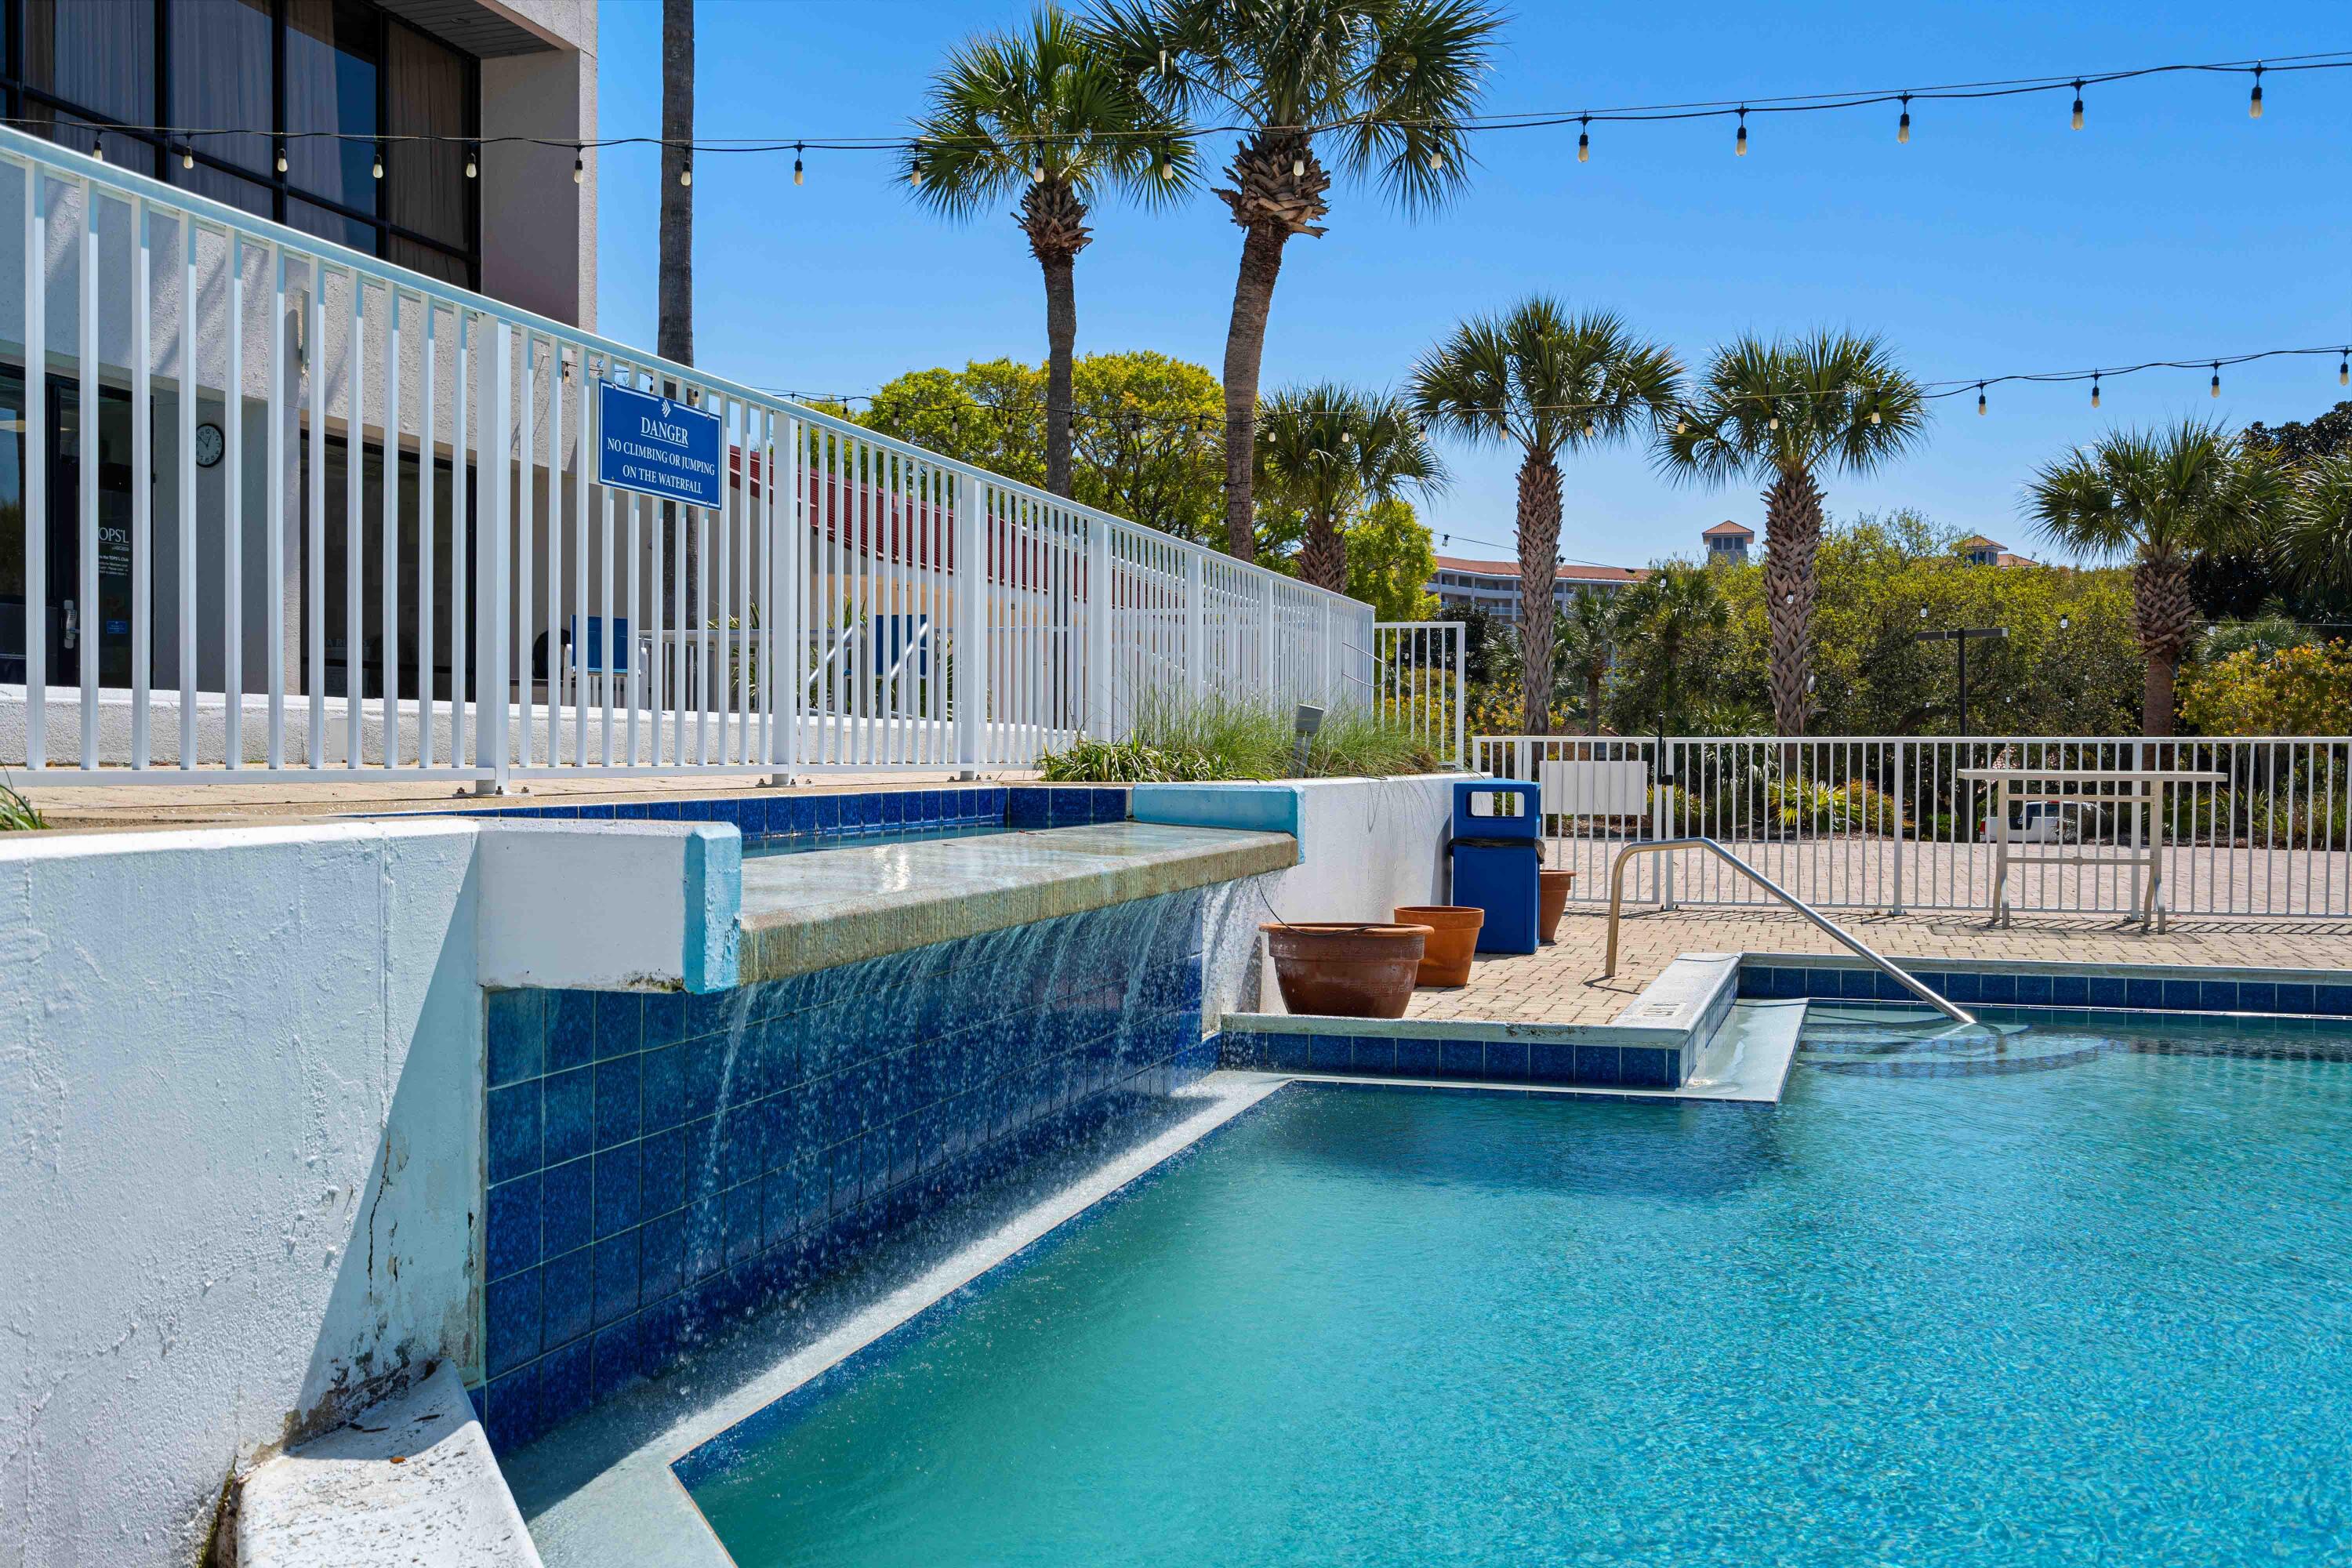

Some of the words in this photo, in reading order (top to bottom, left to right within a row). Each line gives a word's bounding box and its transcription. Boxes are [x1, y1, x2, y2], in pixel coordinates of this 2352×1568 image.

[641, 416, 688, 445] DANGER
[607, 437, 622, 452] NO
[623, 441, 668, 463] CLIMBING
[669, 453, 681, 467] OR
[681, 456, 715, 476] JUMPING
[622, 464, 637, 480] ON
[638, 467, 657, 484] THE
[658, 472, 702, 495] WATERFALL
[98, 527, 129, 543] OPS'L
